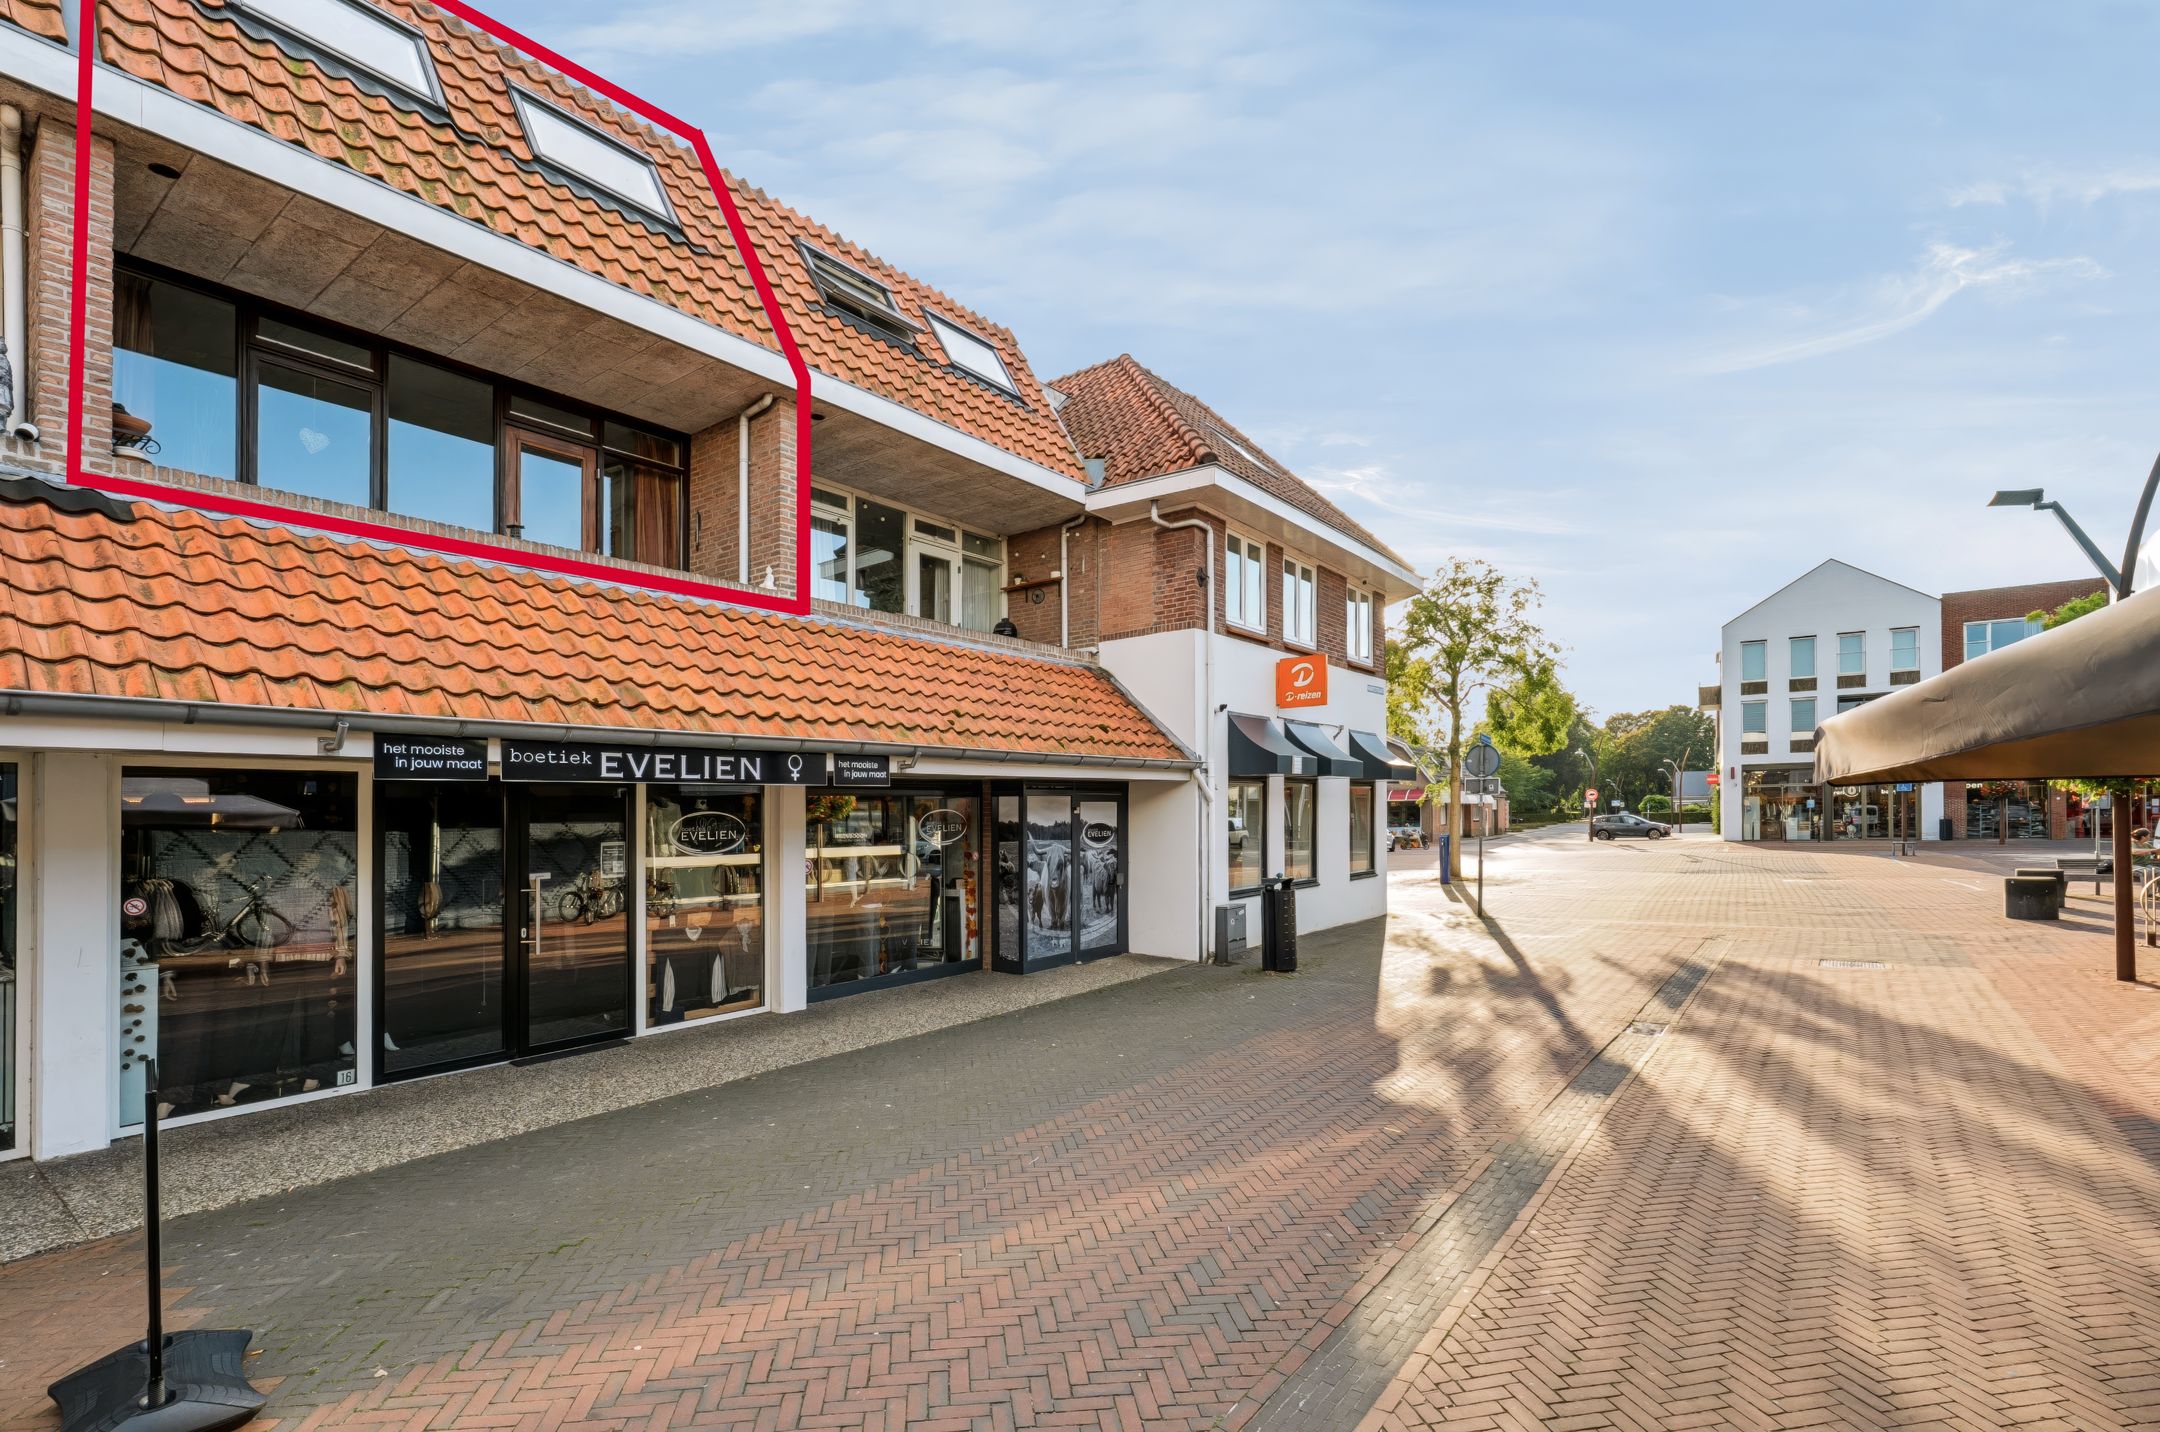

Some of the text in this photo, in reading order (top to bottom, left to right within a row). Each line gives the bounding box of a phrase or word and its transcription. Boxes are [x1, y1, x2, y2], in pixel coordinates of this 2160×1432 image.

[1285, 690, 1322, 702] D-reizen
[383, 742, 465, 756] het mooiste
[395, 756, 483, 771] in jouw maat
[509, 748, 762, 781] boetiek EVELIEN
[838, 760, 879, 769] het mooiste
[843, 769, 851, 778] in
[851, 769, 868, 780] jouw
[926, 823, 962, 833] EVELIEN
[681, 830, 737, 841] EVELIEN
[1087, 830, 1112, 838] EVELIEN
[341, 1071, 352, 1083] 16
